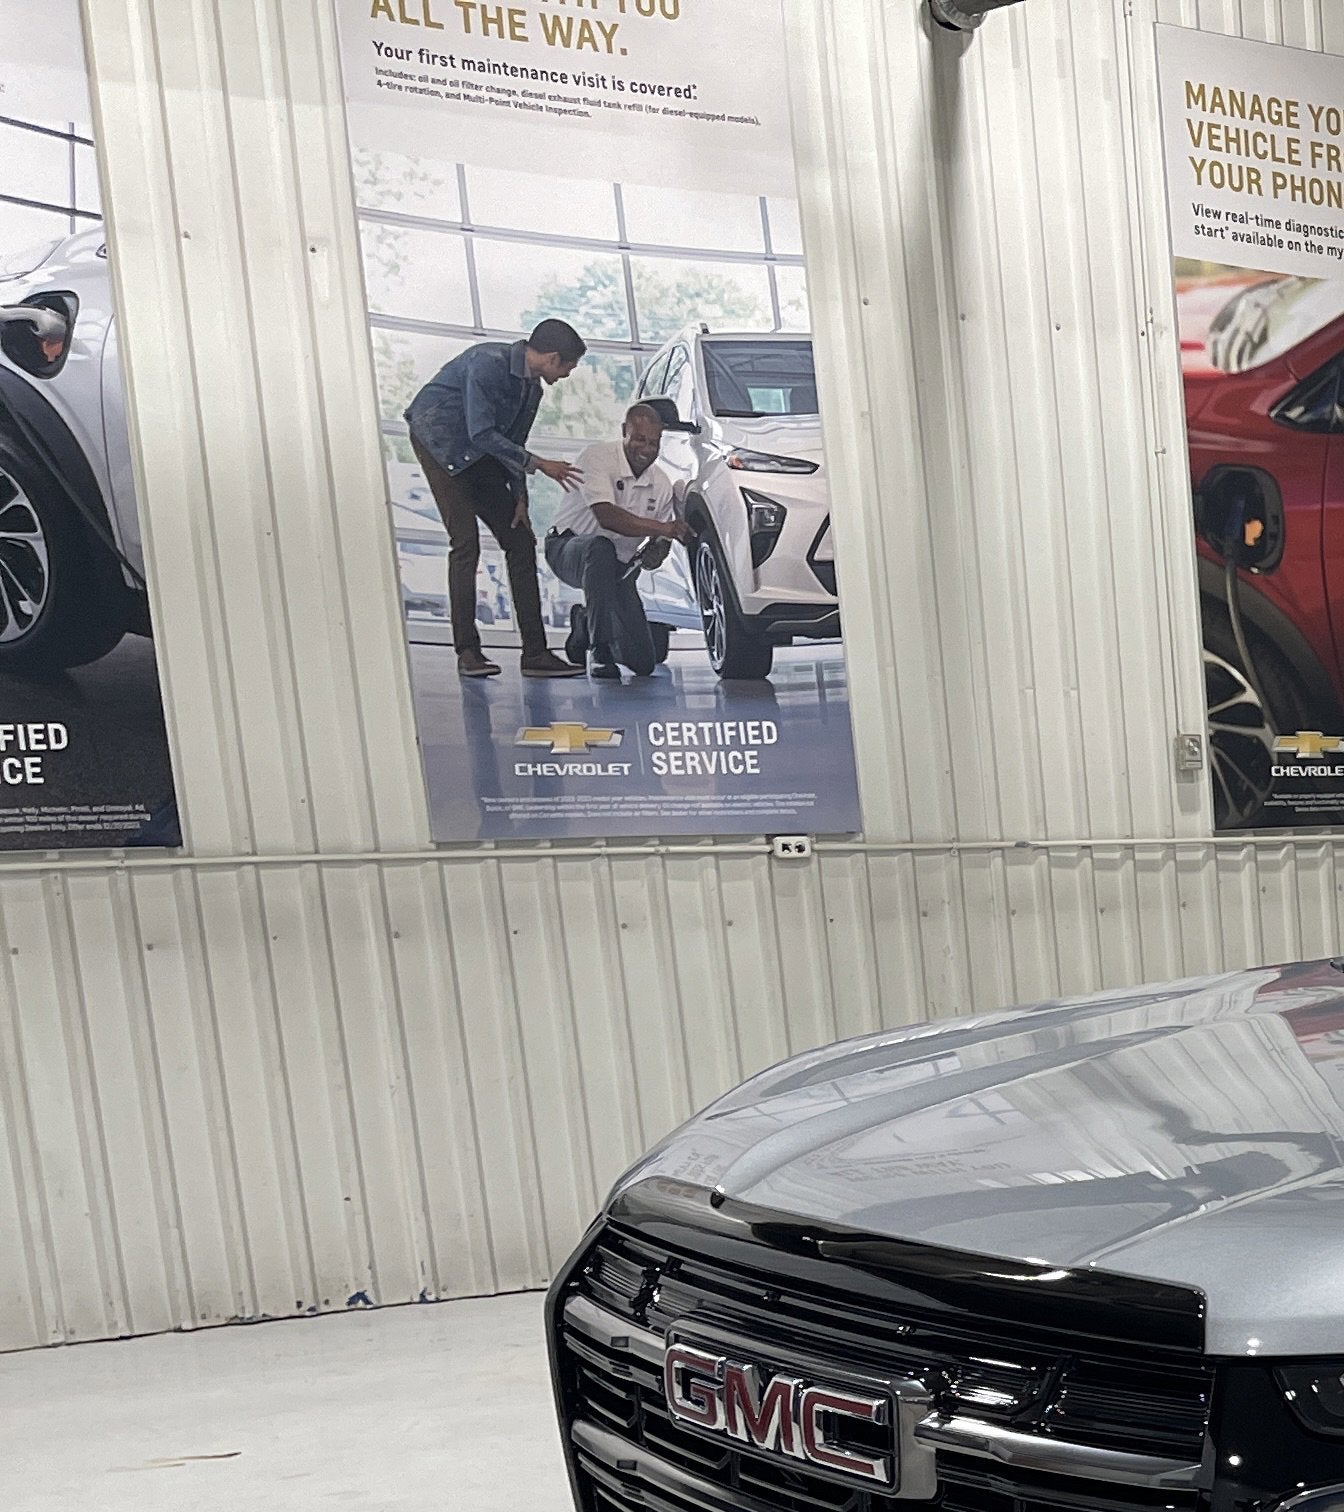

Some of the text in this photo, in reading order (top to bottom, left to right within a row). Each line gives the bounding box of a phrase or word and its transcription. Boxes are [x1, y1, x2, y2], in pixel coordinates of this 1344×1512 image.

[370, 0, 628, 56] ALL THE WAY.
[372, 40, 413, 61] Your
[418, 48, 456, 68] first
[462, 57, 568, 85] maintenance
[572, 70, 607, 90] visit
[611, 75, 625, 92] is
[431, 78, 447, 87] and
[521, 89, 546, 100] diesel
[603, 100, 622, 110] tank
[445, 92, 461, 101] and
[512, 101, 543, 113] Vehicle
[1185, 80, 1300, 129] MANAGE
[1186, 118, 1301, 167] VEHICLE
[1189, 156, 1263, 197] YOUR
[1192, 202, 1221, 220] View
[1225, 208, 1281, 230] real-time
[1232, 228, 1284, 249] available
[1287, 240, 1301, 251] on
[1305, 240, 1324, 255] the
[649, 720, 778, 747] CERTIFIED
[515, 763, 632, 776] CHEVROLET
[651, 750, 761, 775] SERVICE
[664, 1343, 890, 1483] GMC
